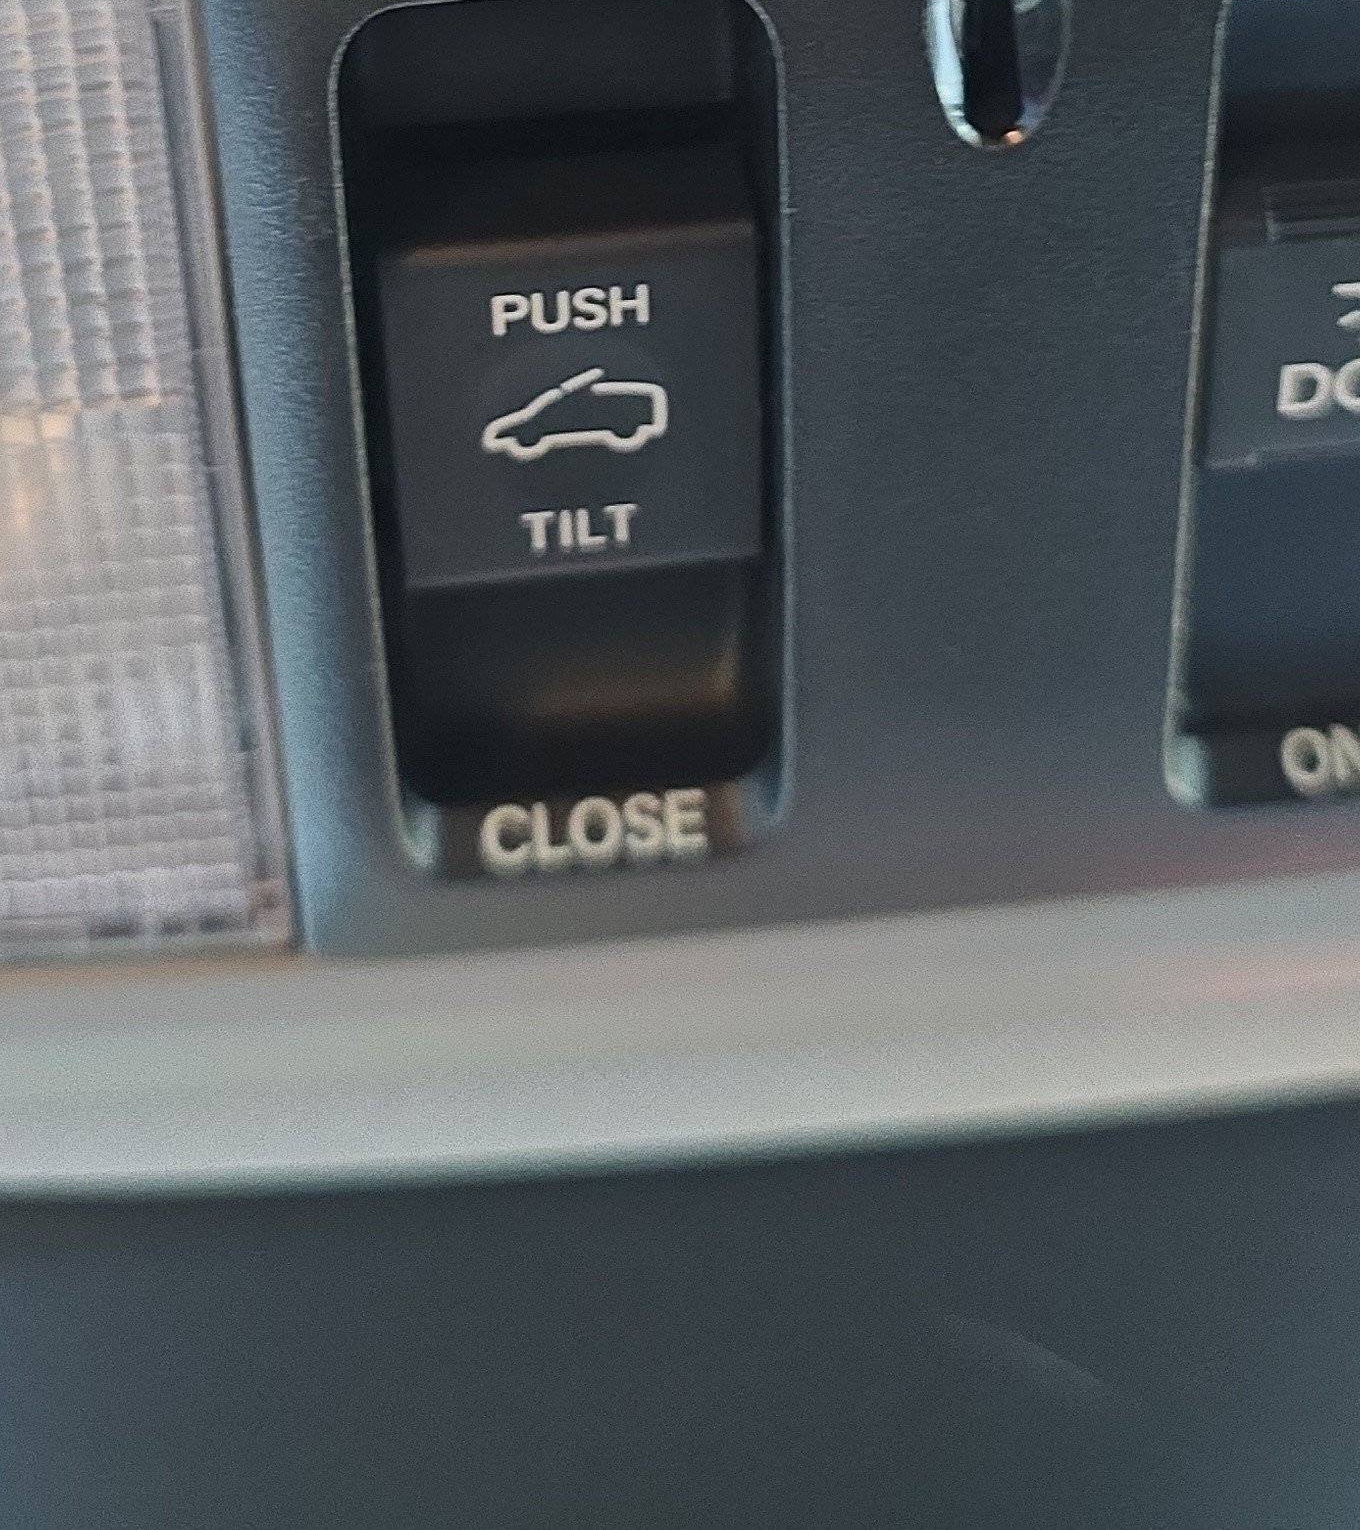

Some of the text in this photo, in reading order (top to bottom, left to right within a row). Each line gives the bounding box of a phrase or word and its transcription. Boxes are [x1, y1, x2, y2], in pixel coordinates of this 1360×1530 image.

[489, 283, 651, 337] PUSH
[520, 501, 639, 553] TILT
[478, 790, 708, 873] CLOSE
